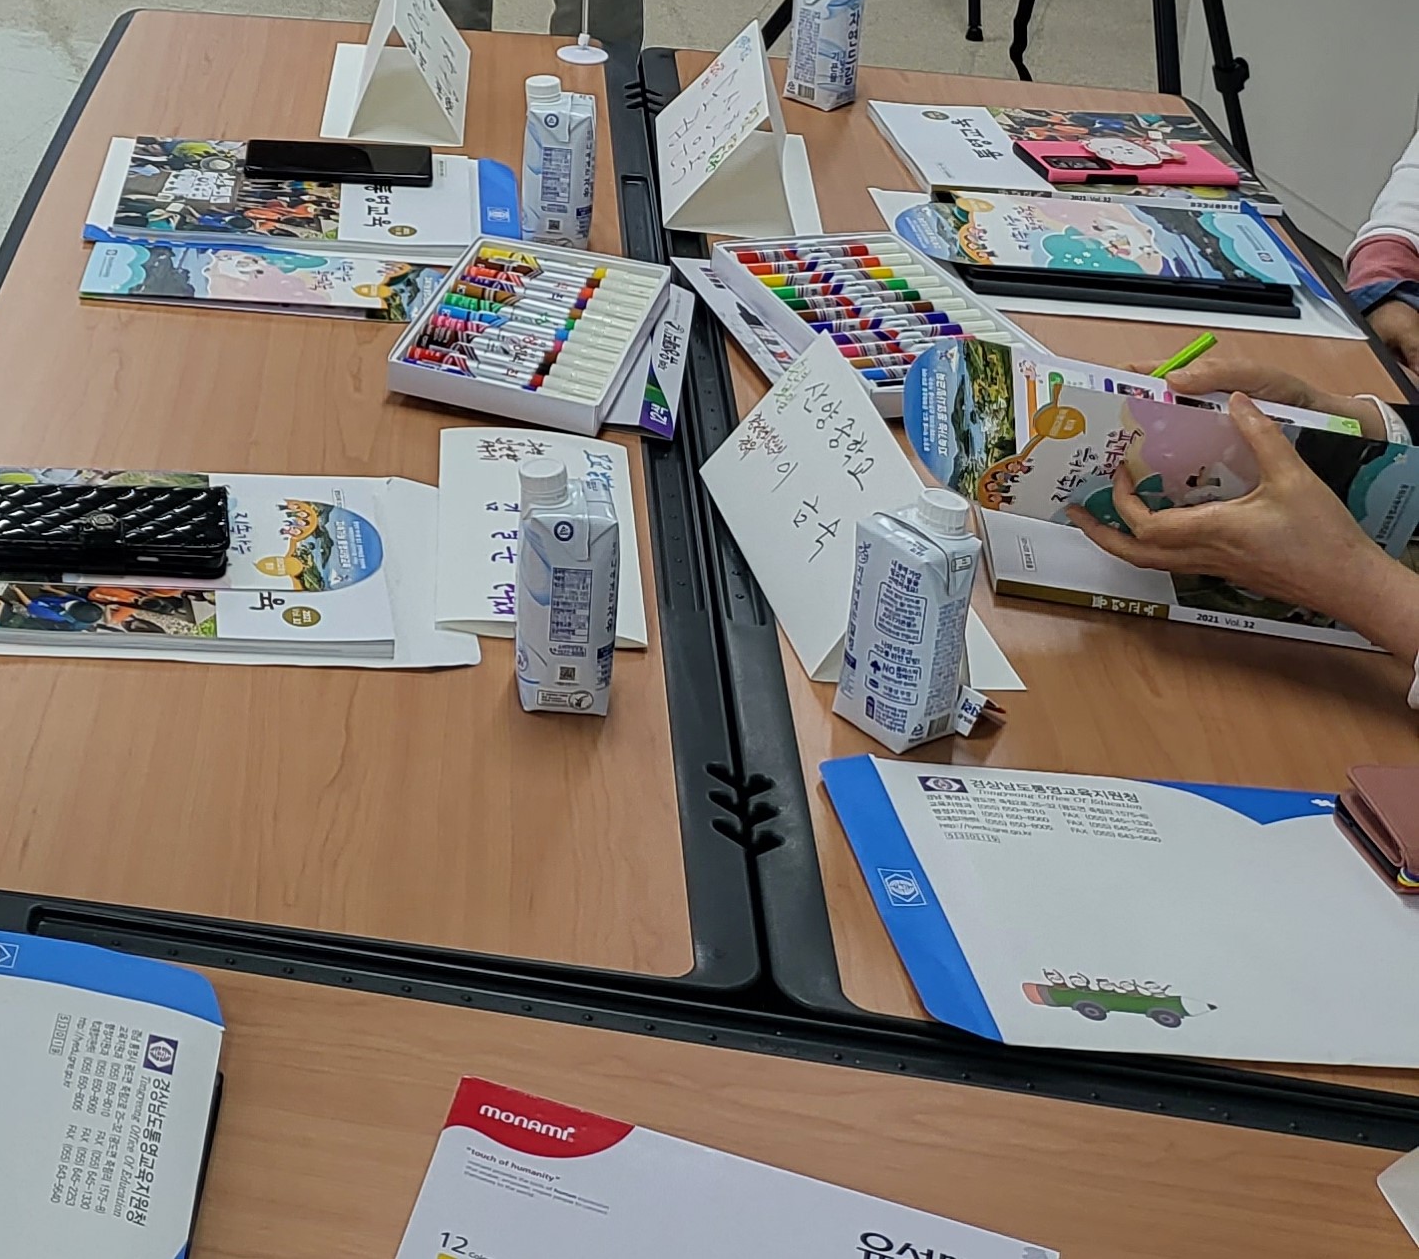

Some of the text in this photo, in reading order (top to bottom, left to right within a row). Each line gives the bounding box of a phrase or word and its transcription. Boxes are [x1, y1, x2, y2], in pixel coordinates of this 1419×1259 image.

[951, 118, 1004, 161] 통영교육
[805, 382, 874, 492] 산양중학교
[771, 462, 841, 563] 이 금숙
[1092, 594, 1255, 629] 통영교육 2021 32
[882, 663, 895, 675] NO
[970, 779, 1140, 803] 경상남도통영교육지원청
[64, 1123, 76, 1140] FAX
[79, 1126, 91, 1143] FAX
[93, 1129, 106, 1146] FAX
[480, 1105, 576, 1142] monami
[112, 1074, 151, 1217] Tongyeong Office Of Education
[124, 1076, 173, 1227] 경상남도통영교육지원청
[79, 1170, 97, 1210] 645-1330
[439, 1232, 467, 1255] 12
